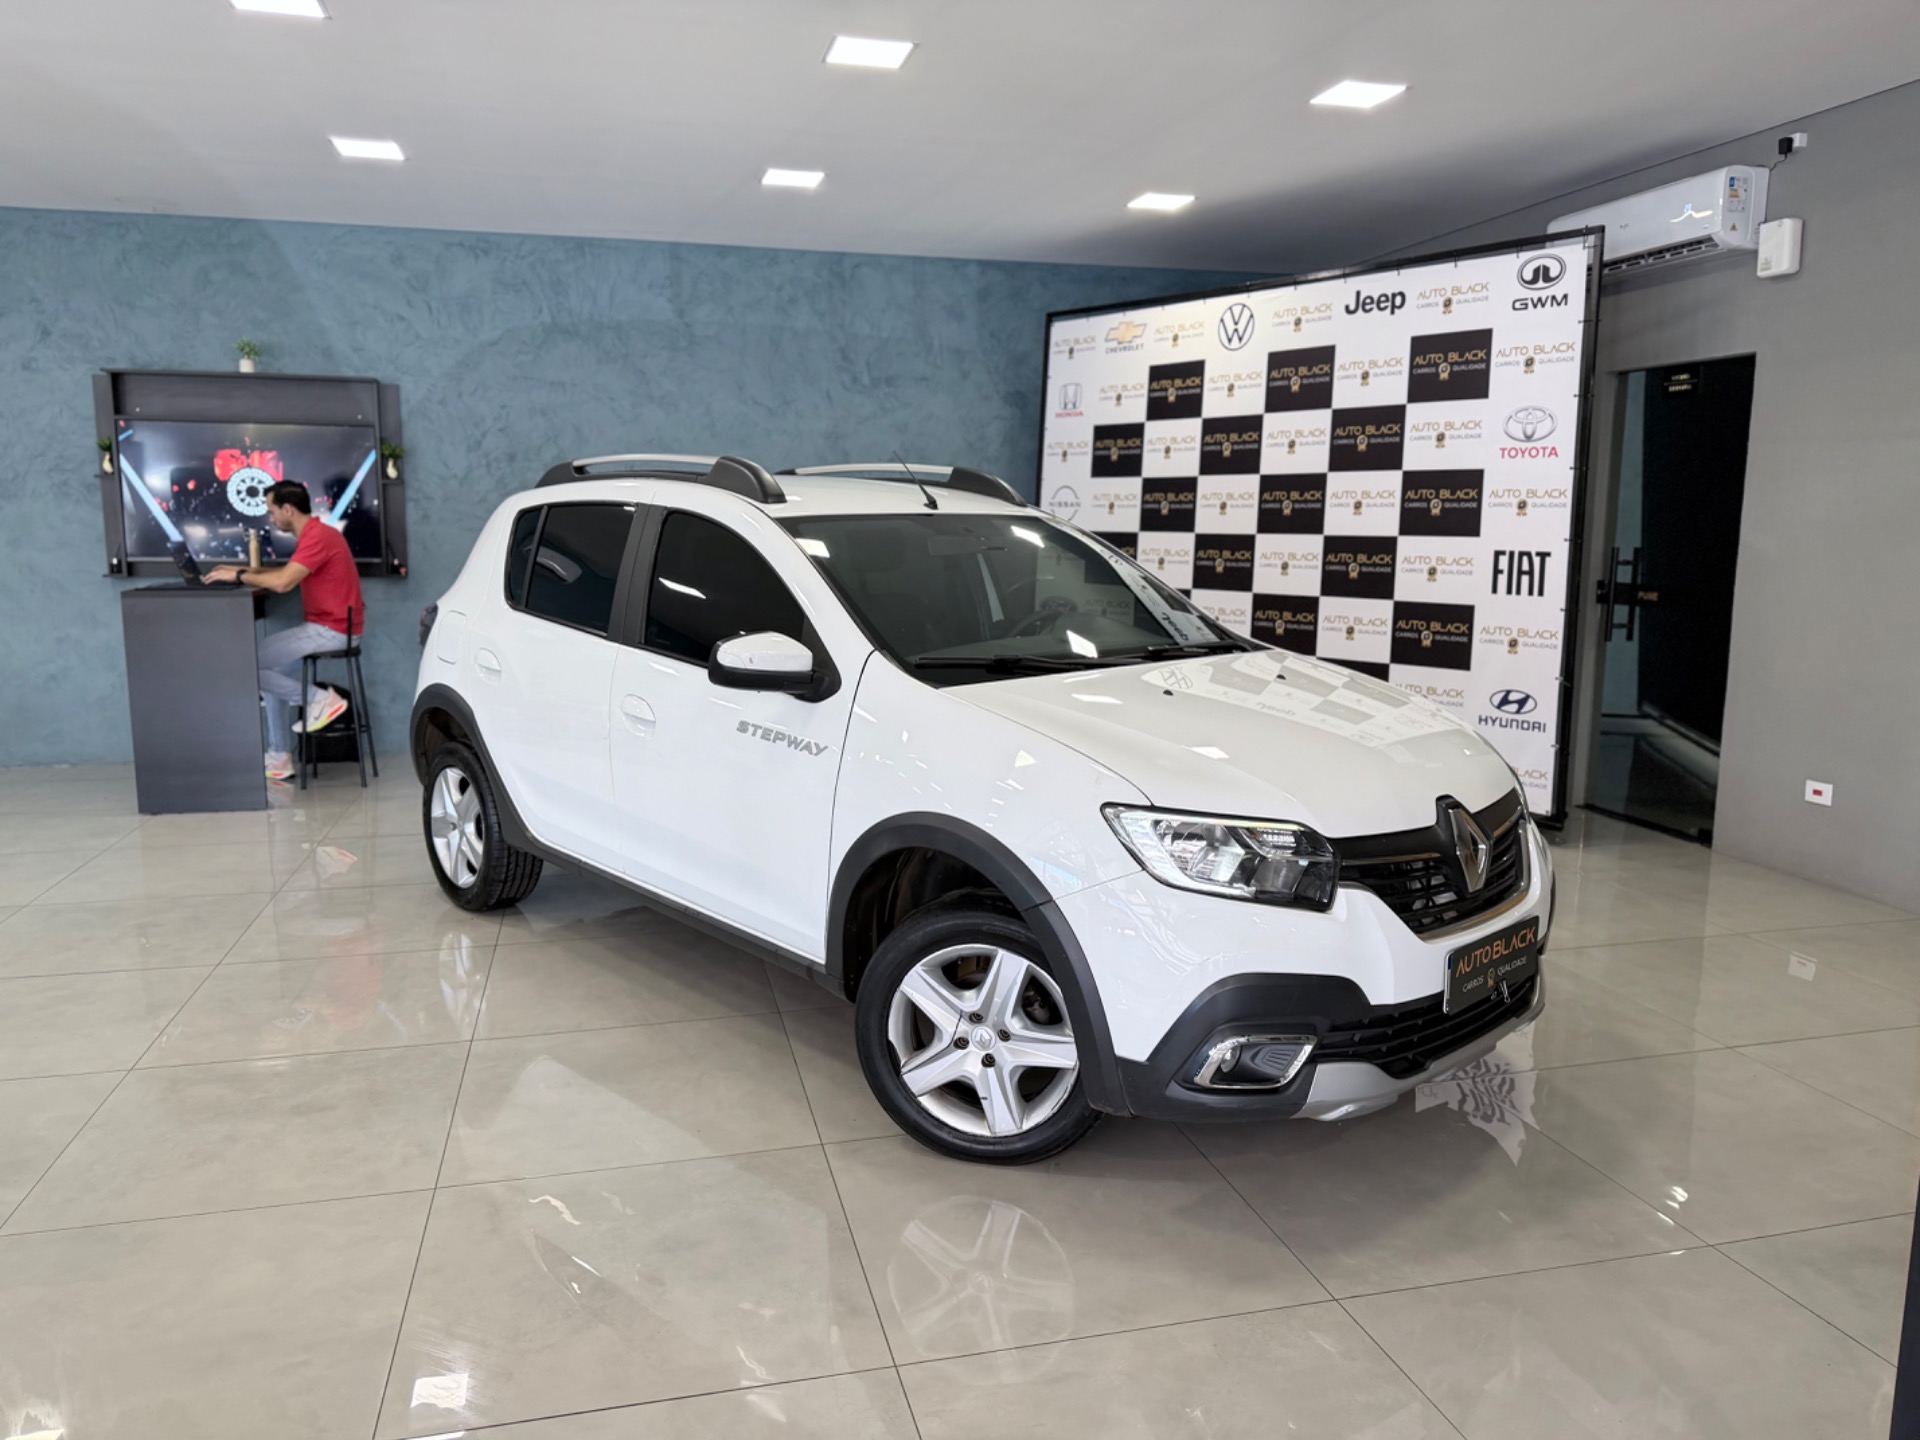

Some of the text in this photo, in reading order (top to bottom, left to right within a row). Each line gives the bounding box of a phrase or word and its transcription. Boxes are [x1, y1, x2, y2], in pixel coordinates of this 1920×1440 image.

[1417, 282, 1490, 300] AUTO BLACK
[1345, 290, 1406, 315] Jeep
[1512, 294, 1569, 311] GWM
[1272, 303, 1333, 319] AUTO BLACK
[1105, 343, 1144, 354] CHEVROLET
[1496, 342, 1576, 358] AUTO BLACK
[1414, 349, 1486, 365] AUTO BLACK
[1338, 358, 1403, 372] AUTO BLACK
[1496, 360, 1520, 368] CARROS
[1208, 371, 1262, 384] AUTO BLACK
[1270, 364, 1331, 378] AUTO BLACK
[1334, 424, 1401, 437] AUTO BLACK
[1410, 420, 1482, 433] AUTO BLACK
[1204, 432, 1259, 442] AUTO BLACK
[1267, 429, 1326, 440] AUTO BLACK
[1499, 446, 1559, 459] TOYOTA
[1226, 492, 1255, 500] BLACK
[1262, 491, 1323, 500] AUTO BLACK
[1331, 490, 1396, 500] AUTO BLACK
[1405, 489, 1478, 500] AUTO BLACK
[1489, 488, 1568, 499] AUTO BLACK
[1197, 550, 1252, 560] AUTO BLACK
[1261, 552, 1319, 562] AUTO BLACK
[1326, 554, 1392, 564] AUTO BLACK
[1402, 556, 1473, 567] AUTO BLACK
[1492, 550, 1552, 597] FIAT
[1255, 611, 1315, 622] AUTO BLACK
[1323, 616, 1388, 628] AUTO BLACK
[1396, 620, 1469, 634] AUTO BLACK
[1480, 626, 1559, 640] AUTO BLACK
[1426, 686, 1464, 699] BLACK
[1479, 715, 1546, 733] HYUNDAI
[736, 720, 829, 756] STEPWAY
[1512, 766, 1548, 781] LACK
